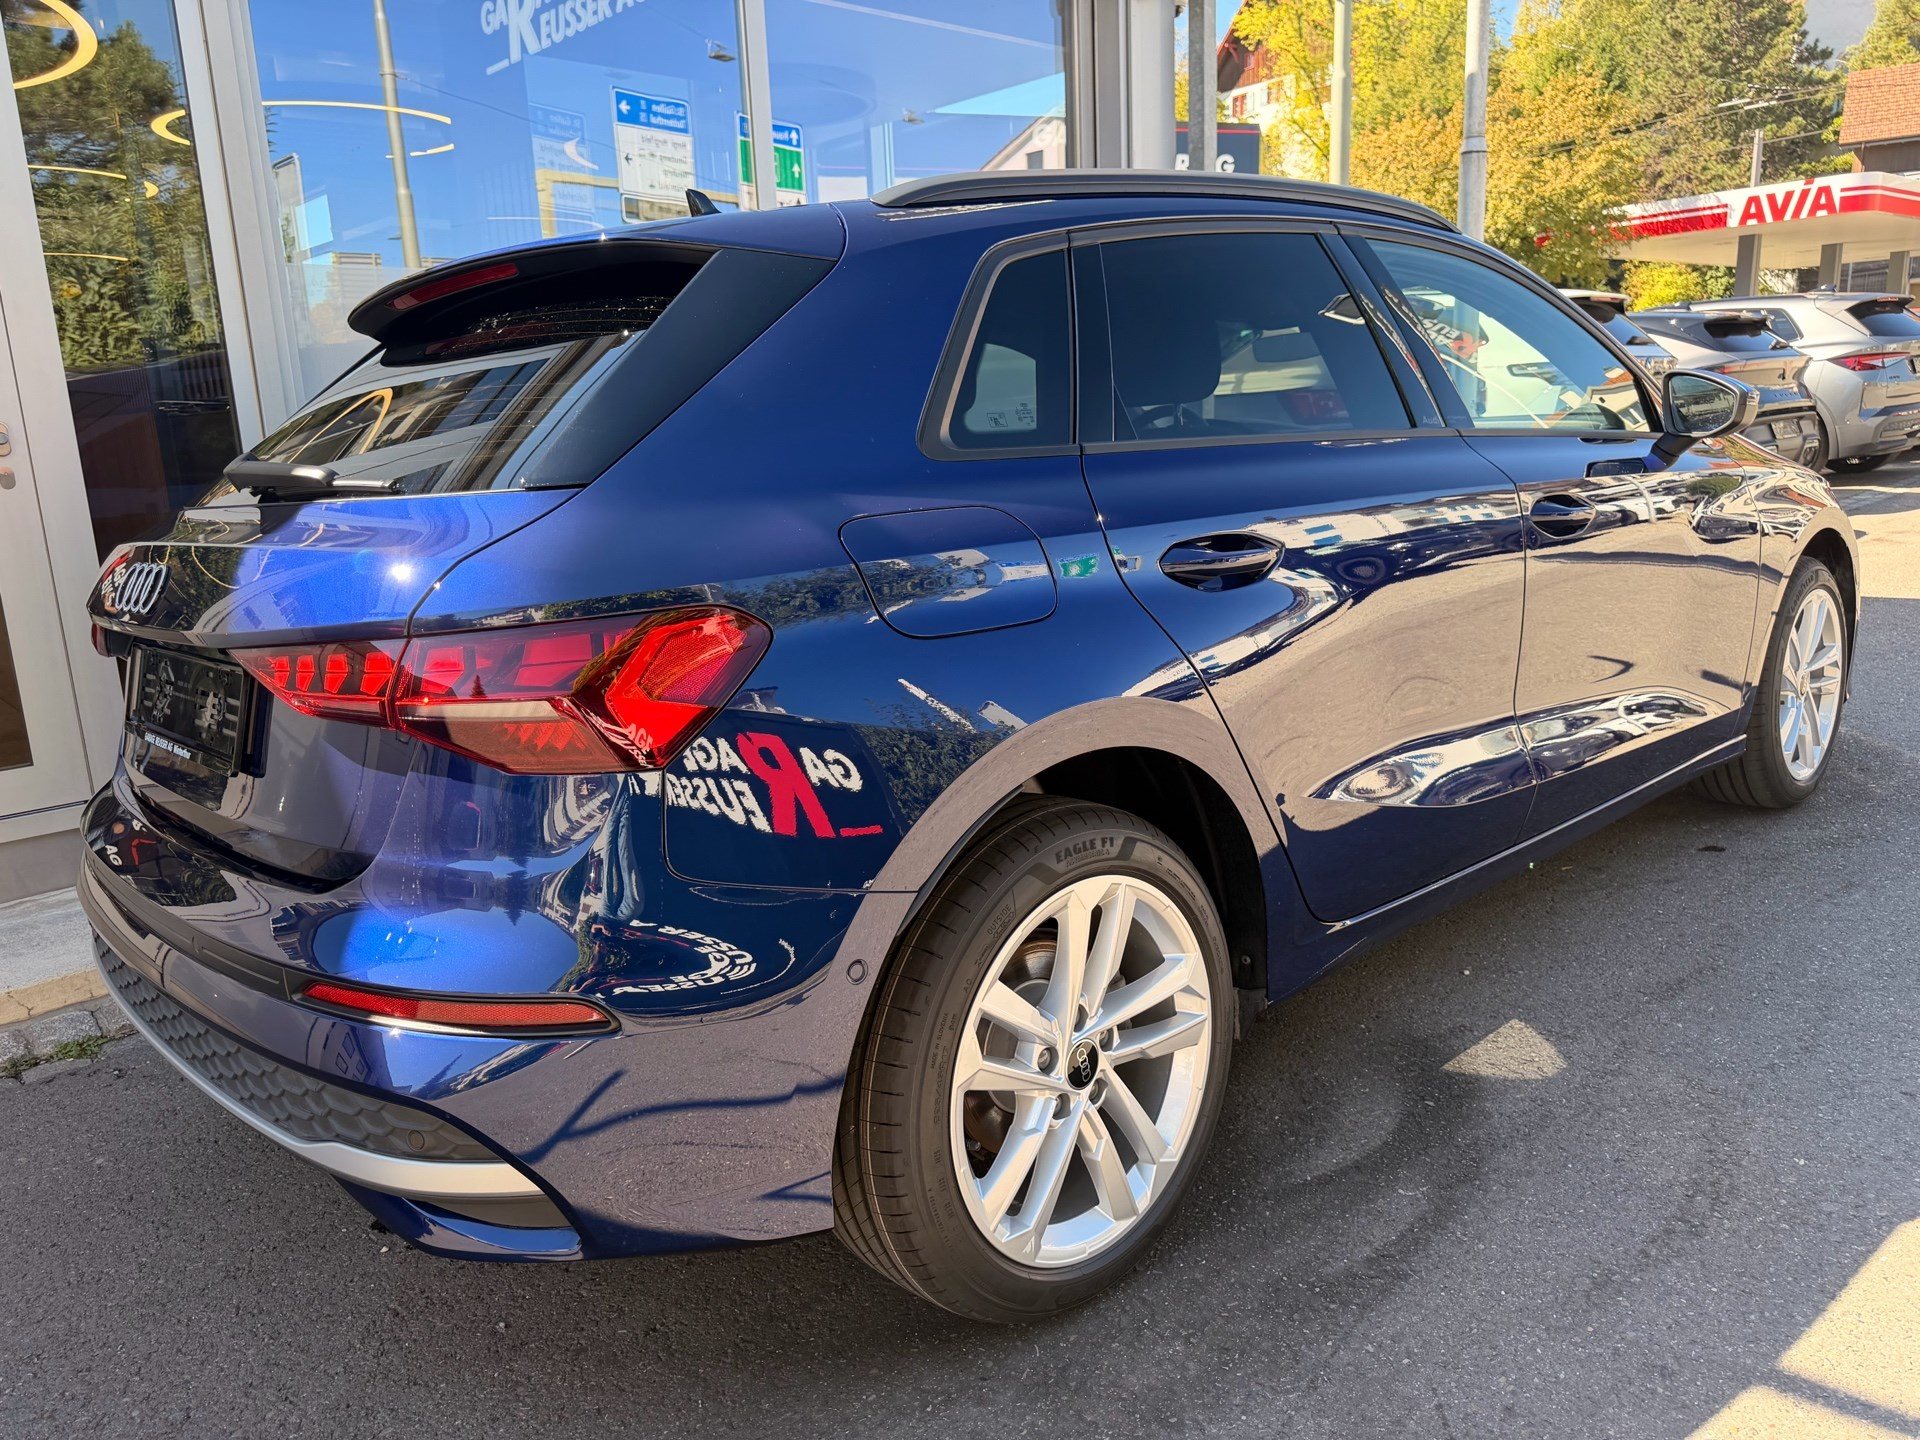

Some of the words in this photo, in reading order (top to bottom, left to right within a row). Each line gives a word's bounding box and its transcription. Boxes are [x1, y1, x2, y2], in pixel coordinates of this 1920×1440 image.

[1738, 178, 1838, 226] AVIA
[1055, 838, 1097, 864] EAGLE
[986, 903, 1012, 936] OUTSIDE
